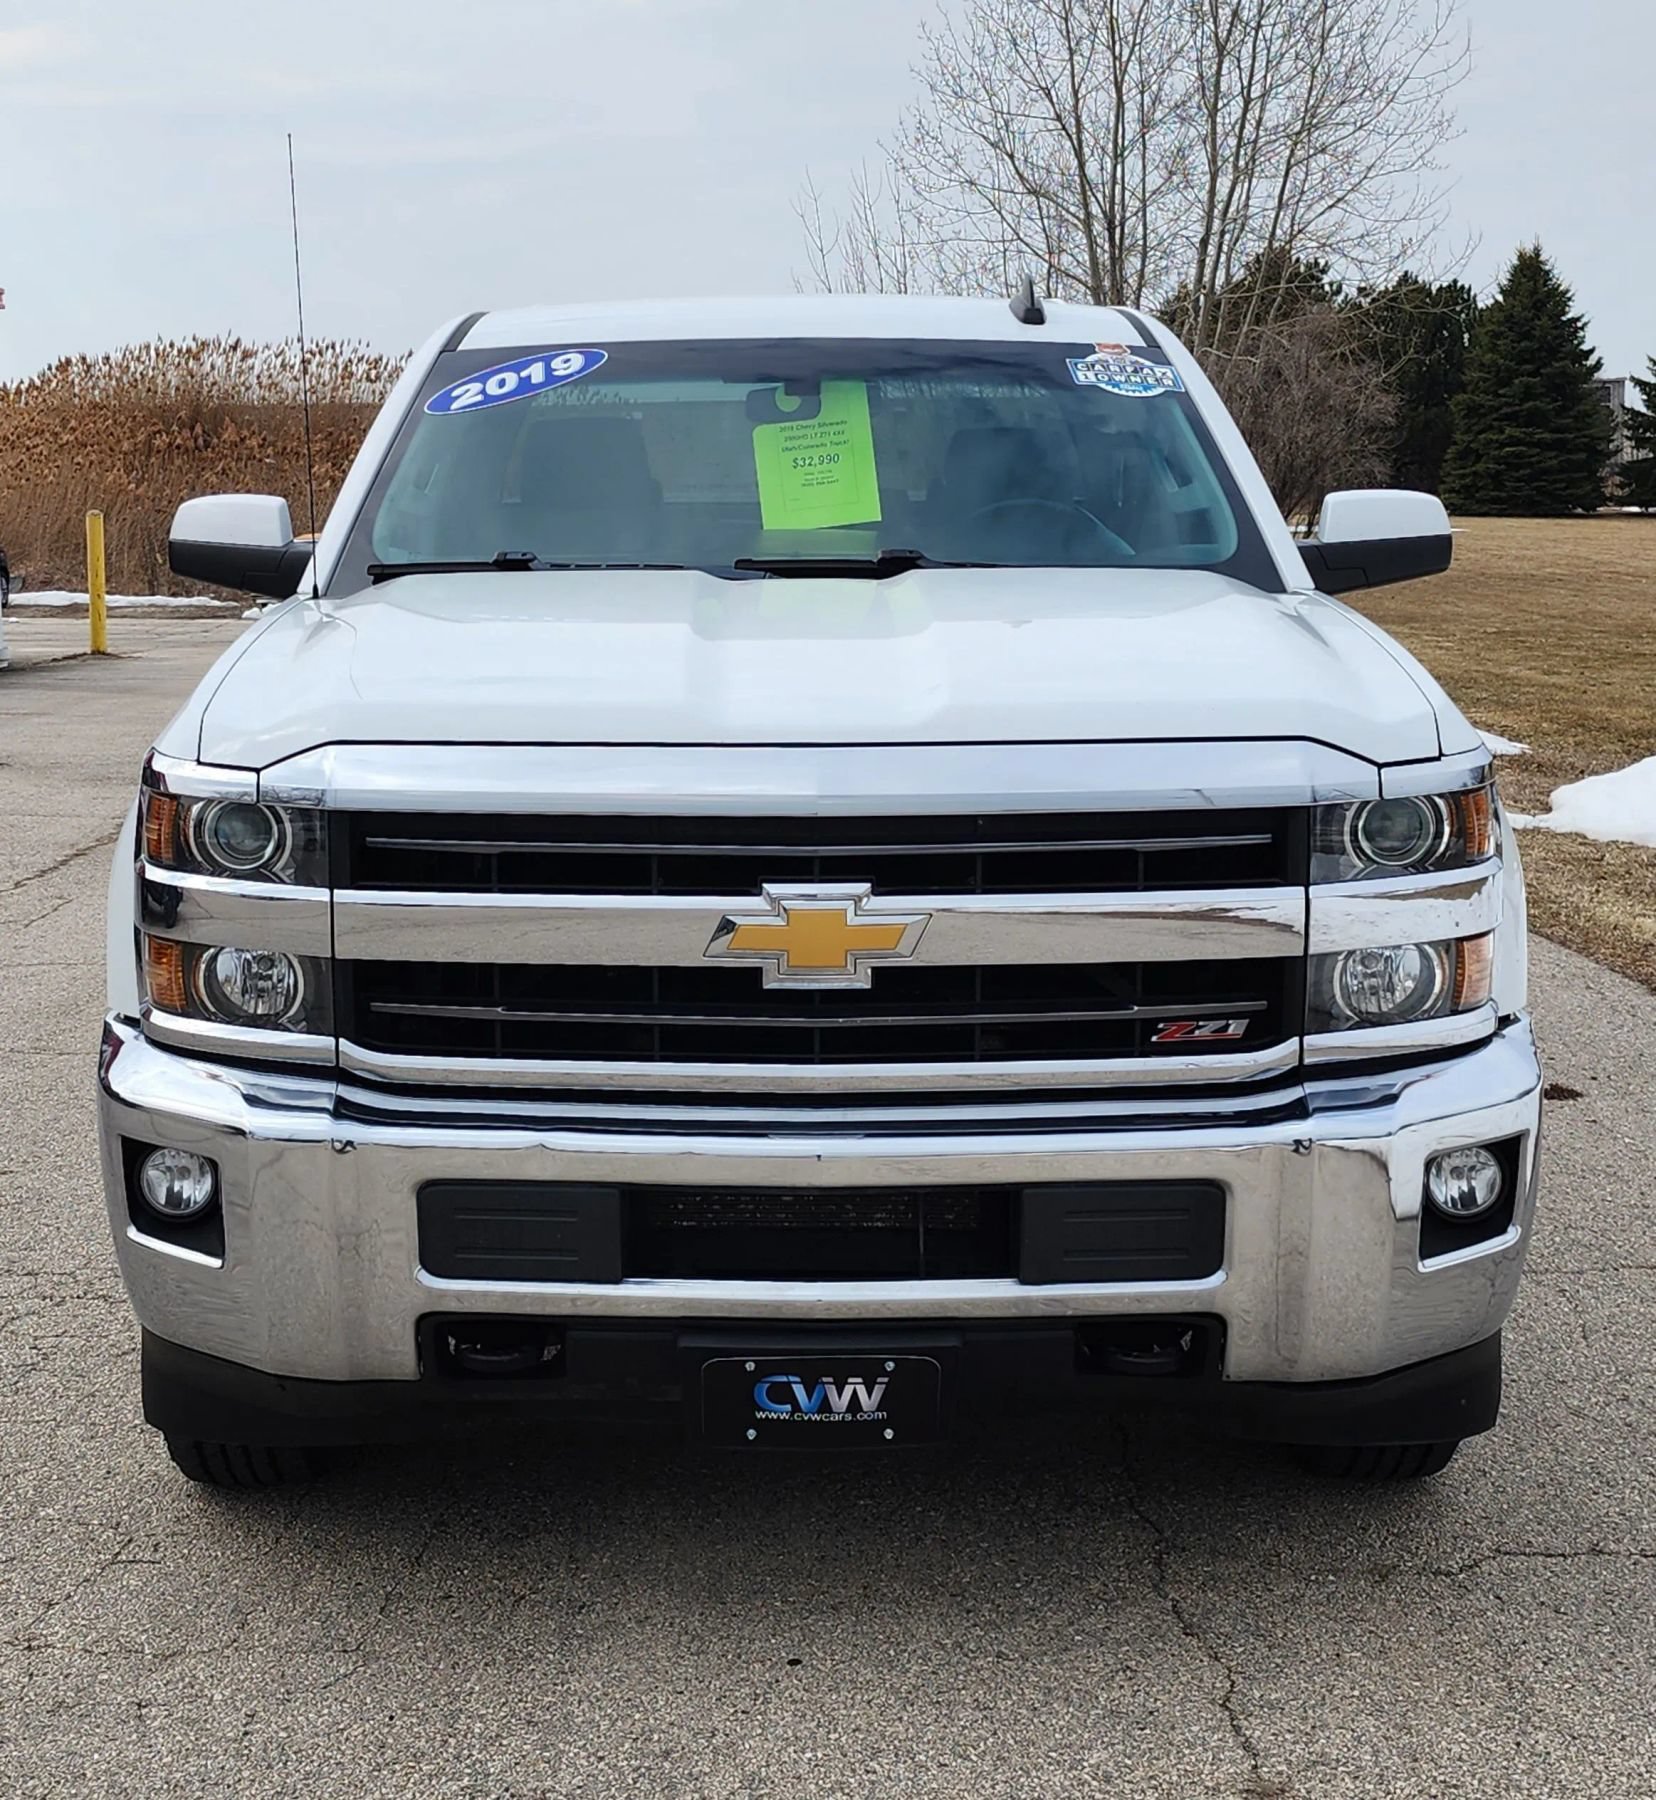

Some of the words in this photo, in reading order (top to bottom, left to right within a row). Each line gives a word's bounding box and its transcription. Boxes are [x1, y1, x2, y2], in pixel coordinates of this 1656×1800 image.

[1076, 362, 1172, 377] CARFAX
[450, 353, 585, 411] 2019
[1096, 373, 1175, 387] OWNER
[792, 453, 840, 469] $32,990
[1151, 1019, 1250, 1041] Z71
[755, 1411, 887, 1422] www.cvwcars.com
